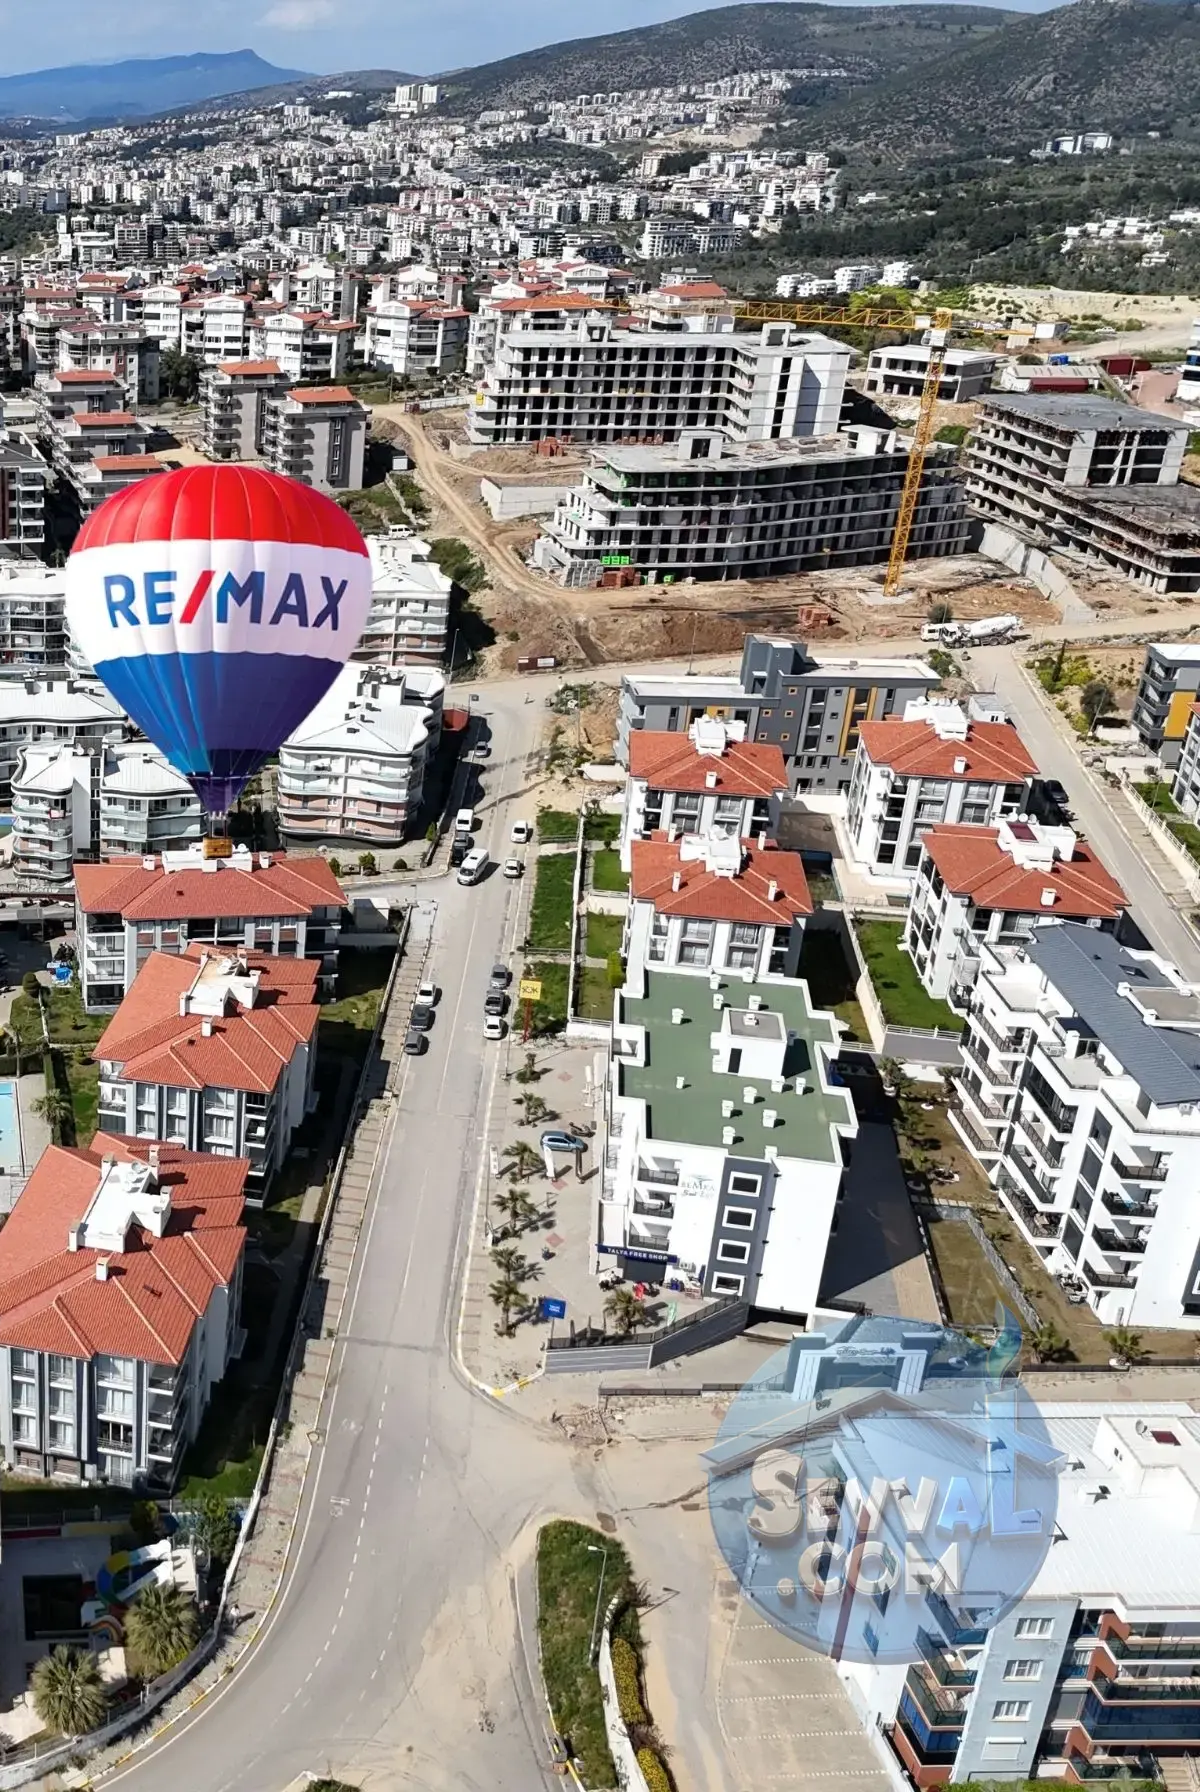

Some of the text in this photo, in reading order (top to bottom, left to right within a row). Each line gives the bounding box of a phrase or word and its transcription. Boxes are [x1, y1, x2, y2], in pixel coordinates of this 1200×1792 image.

[103, 569, 349, 631] RE/MAX
[607, 1247, 669, 1261] TALYA FREE SHOP
